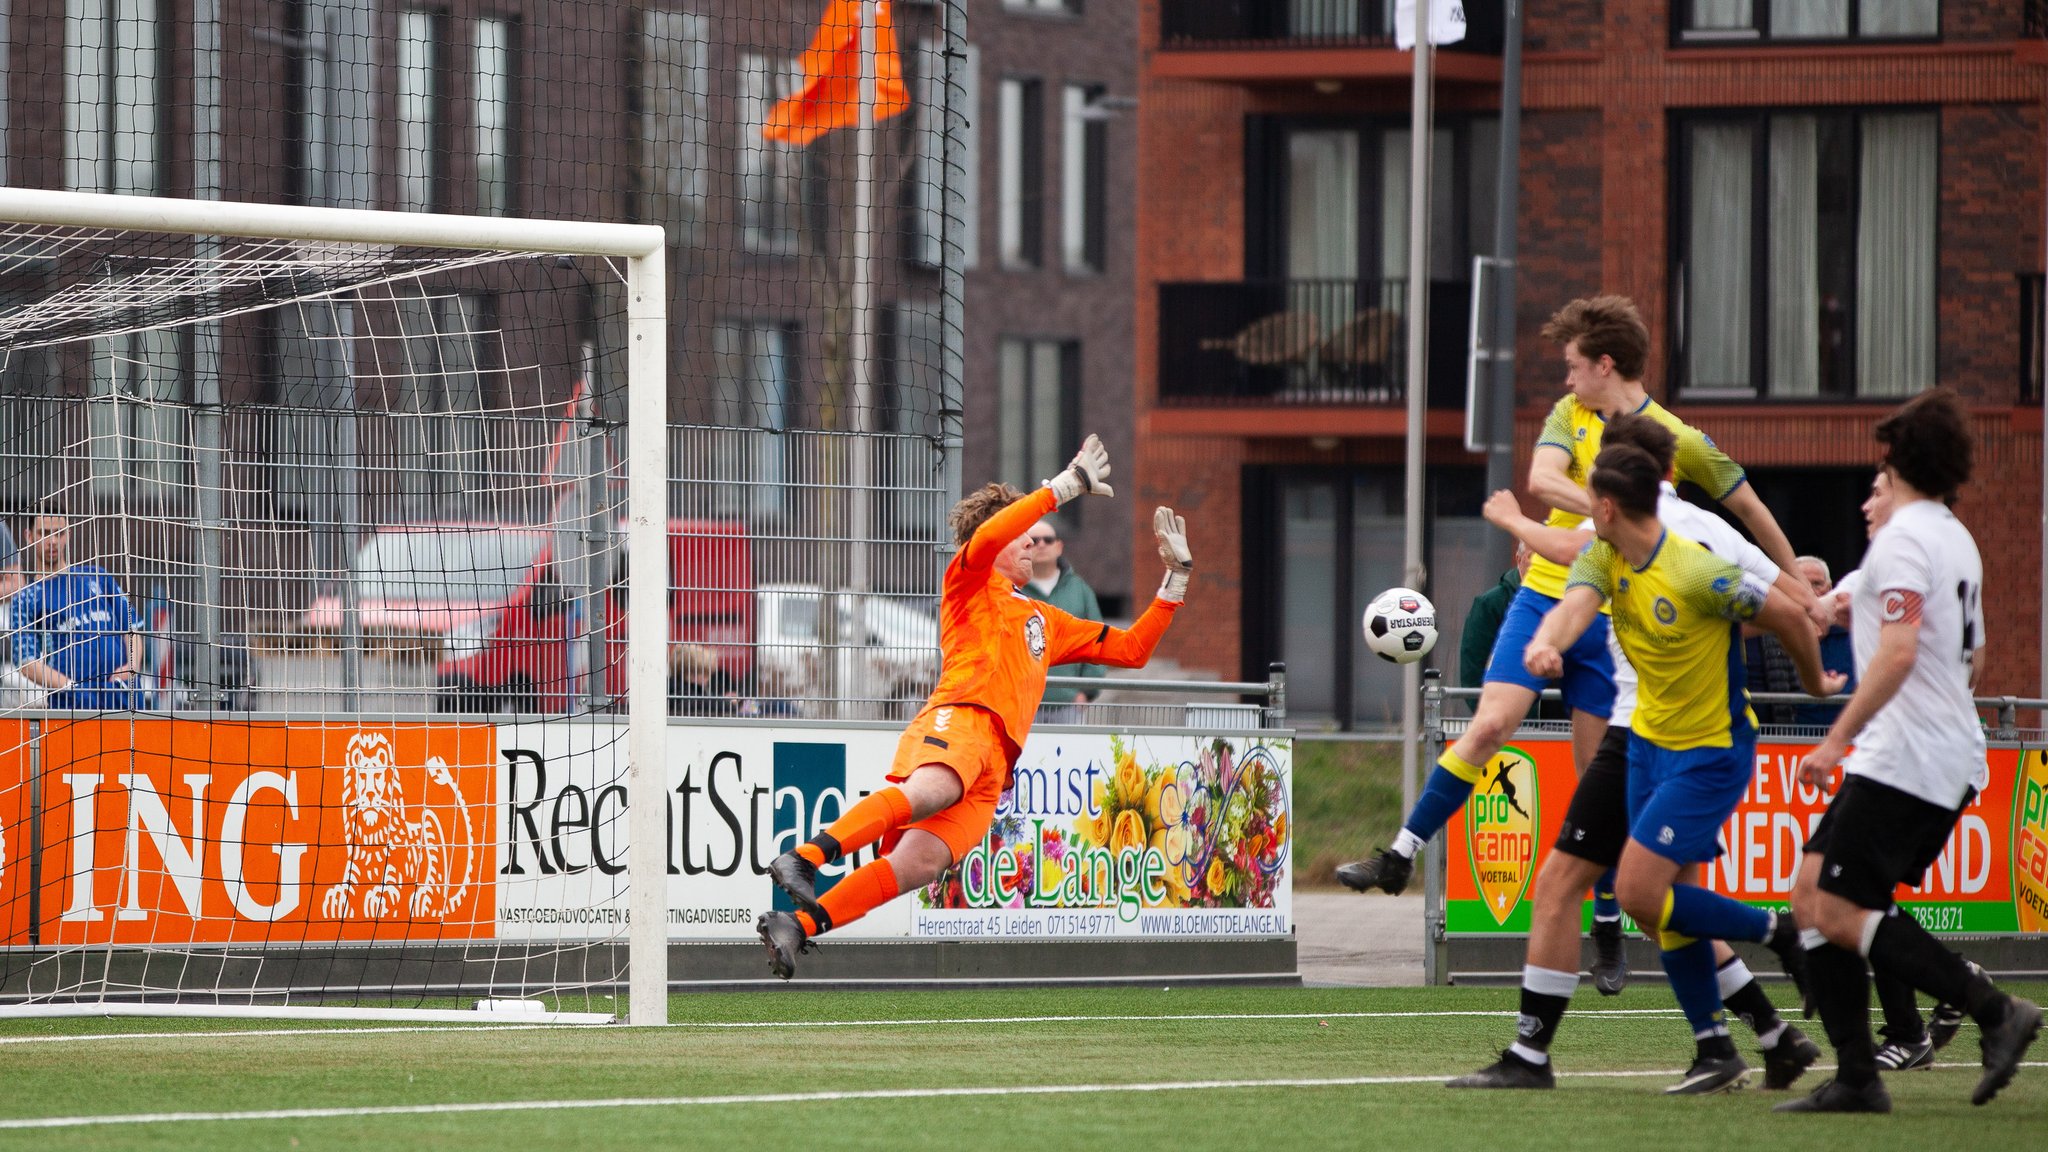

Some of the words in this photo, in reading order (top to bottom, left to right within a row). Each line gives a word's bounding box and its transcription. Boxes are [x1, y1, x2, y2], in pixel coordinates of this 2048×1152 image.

[1883, 590, 1906, 621] C
[994, 745, 1101, 816] mist
[1475, 793, 1509, 832] pro
[2022, 778, 2048, 830] pr
[62, 771, 307, 922] ING
[1475, 832, 1532, 882] camp
[964, 830, 1018, 904] de
[1032, 818, 1166, 922] Lange
[1481, 870, 1518, 883] VOETBAL
[499, 907, 622, 924] VASTGOEDADVOCATEN
[918, 916, 984, 936] Herenstraat
[987, 916, 1001, 935] 45
[1005, 915, 1042, 935] Leiden
[1141, 915, 1288, 934] WWW.BLOEMISTDELANGE.NL
